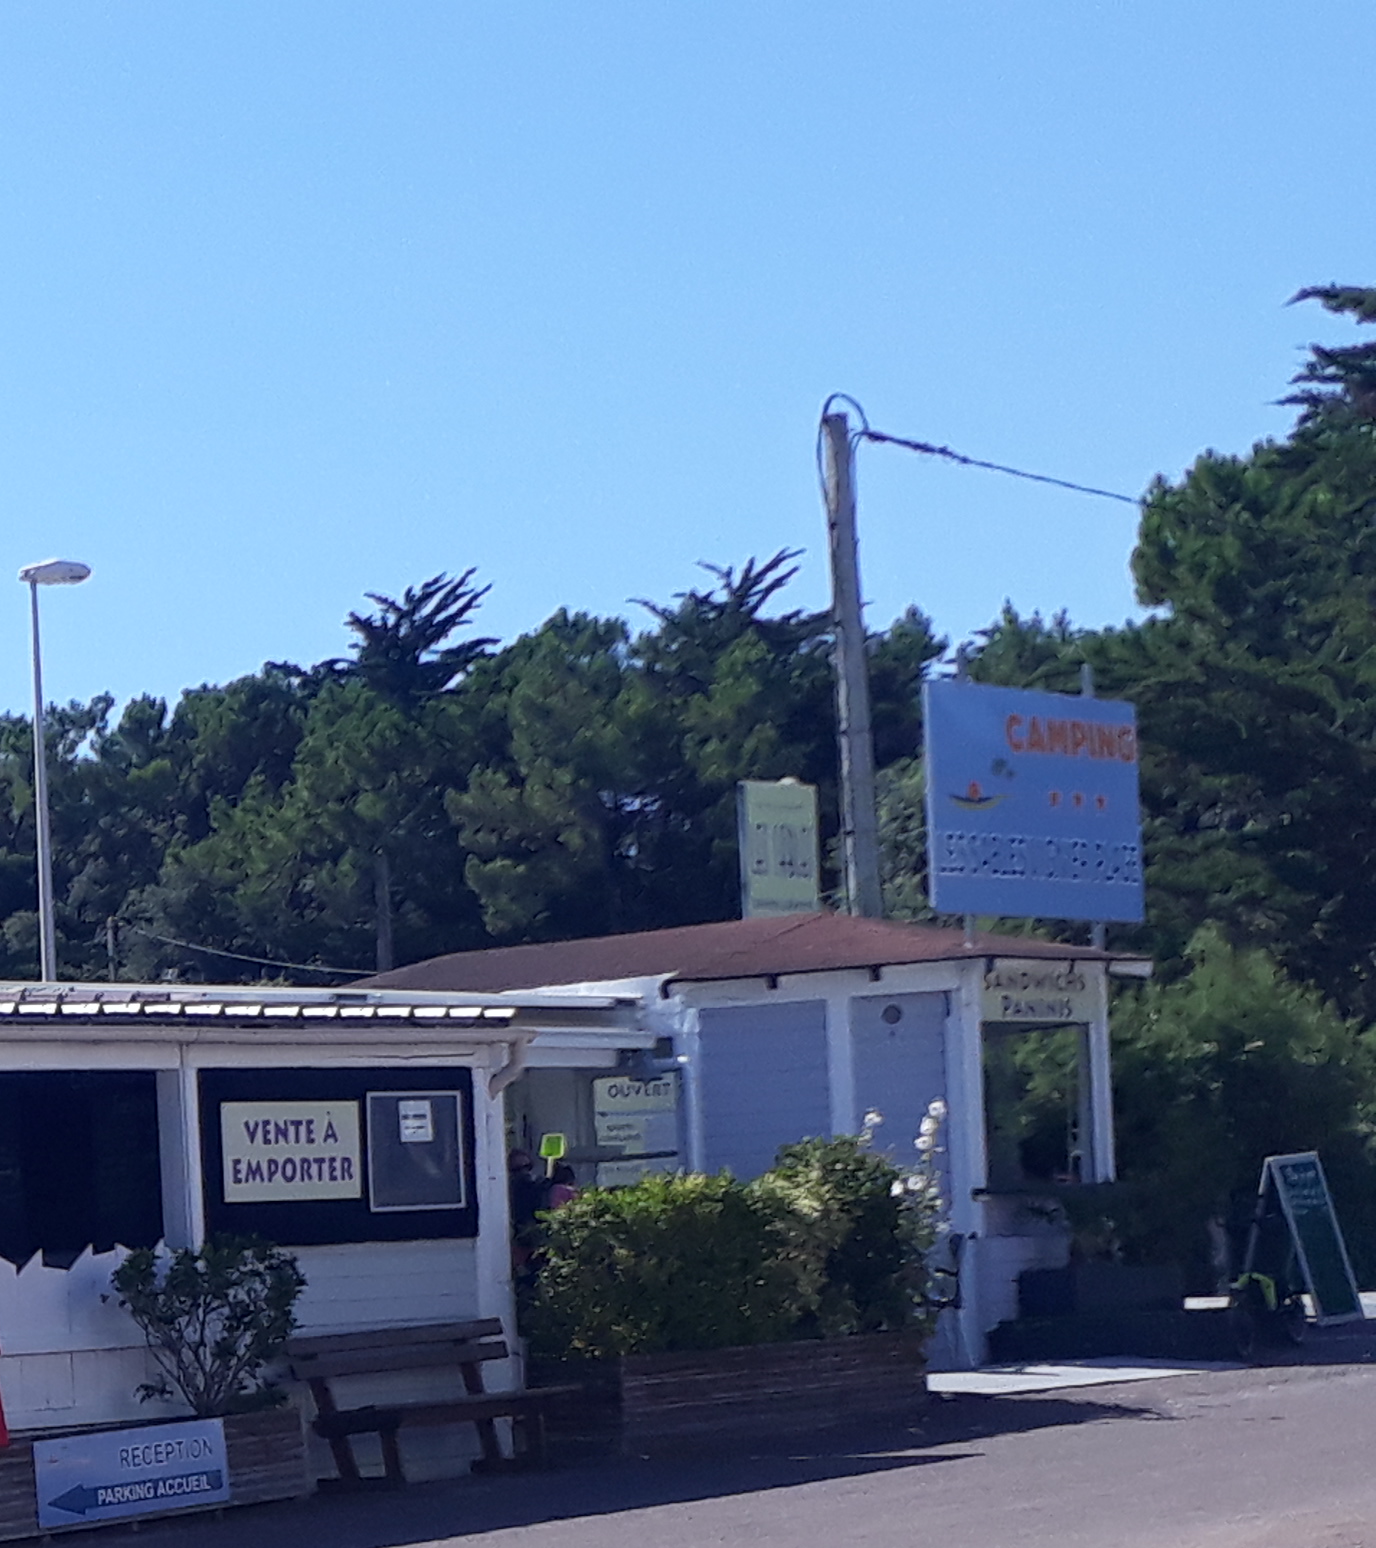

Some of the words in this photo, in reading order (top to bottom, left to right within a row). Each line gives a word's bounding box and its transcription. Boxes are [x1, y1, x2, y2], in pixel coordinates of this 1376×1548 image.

[1005, 713, 1137, 763] CAMPING
[608, 1082, 671, 1098] OUVERT
[243, 1118, 316, 1145] VENTE
[231, 1156, 354, 1185] EMPORTER
[119, 1437, 213, 1469] RECEPTION
[97, 1483, 155, 1506] PARKING
[156, 1473, 211, 1497] ACCUEIL
